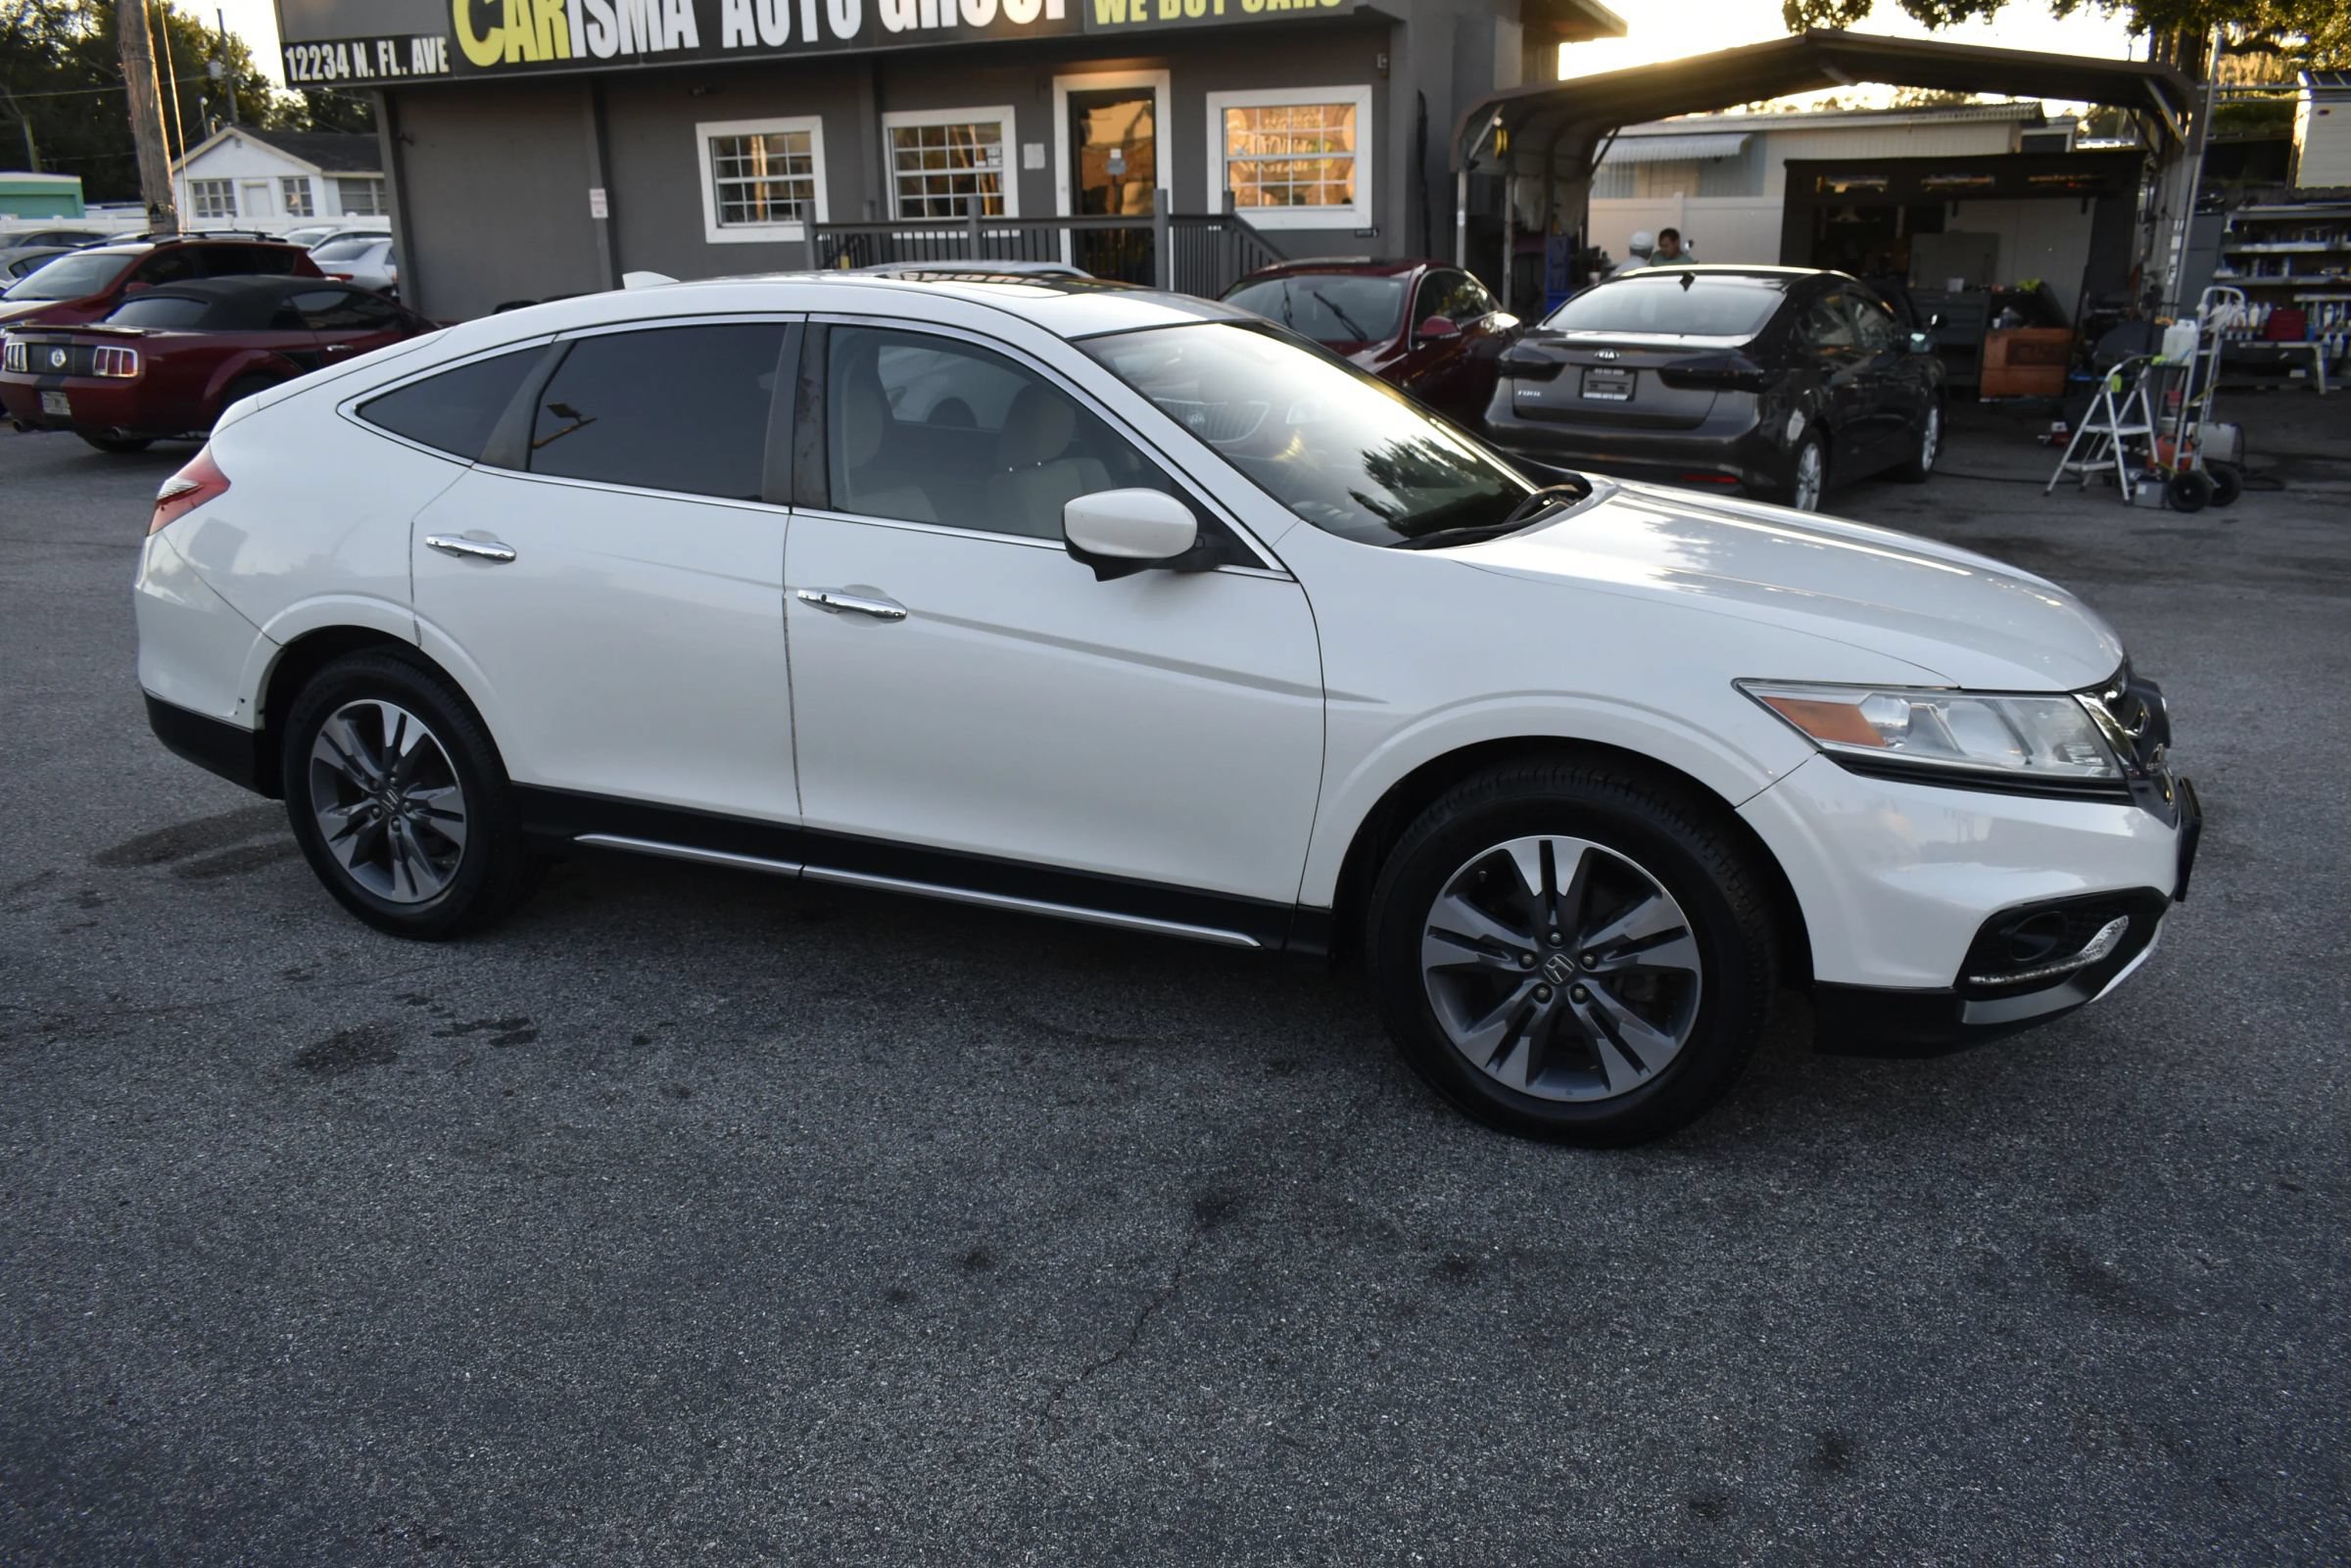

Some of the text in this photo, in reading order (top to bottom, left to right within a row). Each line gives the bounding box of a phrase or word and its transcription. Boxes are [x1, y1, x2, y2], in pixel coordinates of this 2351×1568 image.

[285, 36, 450, 81] 12234 N. FL. AVE
